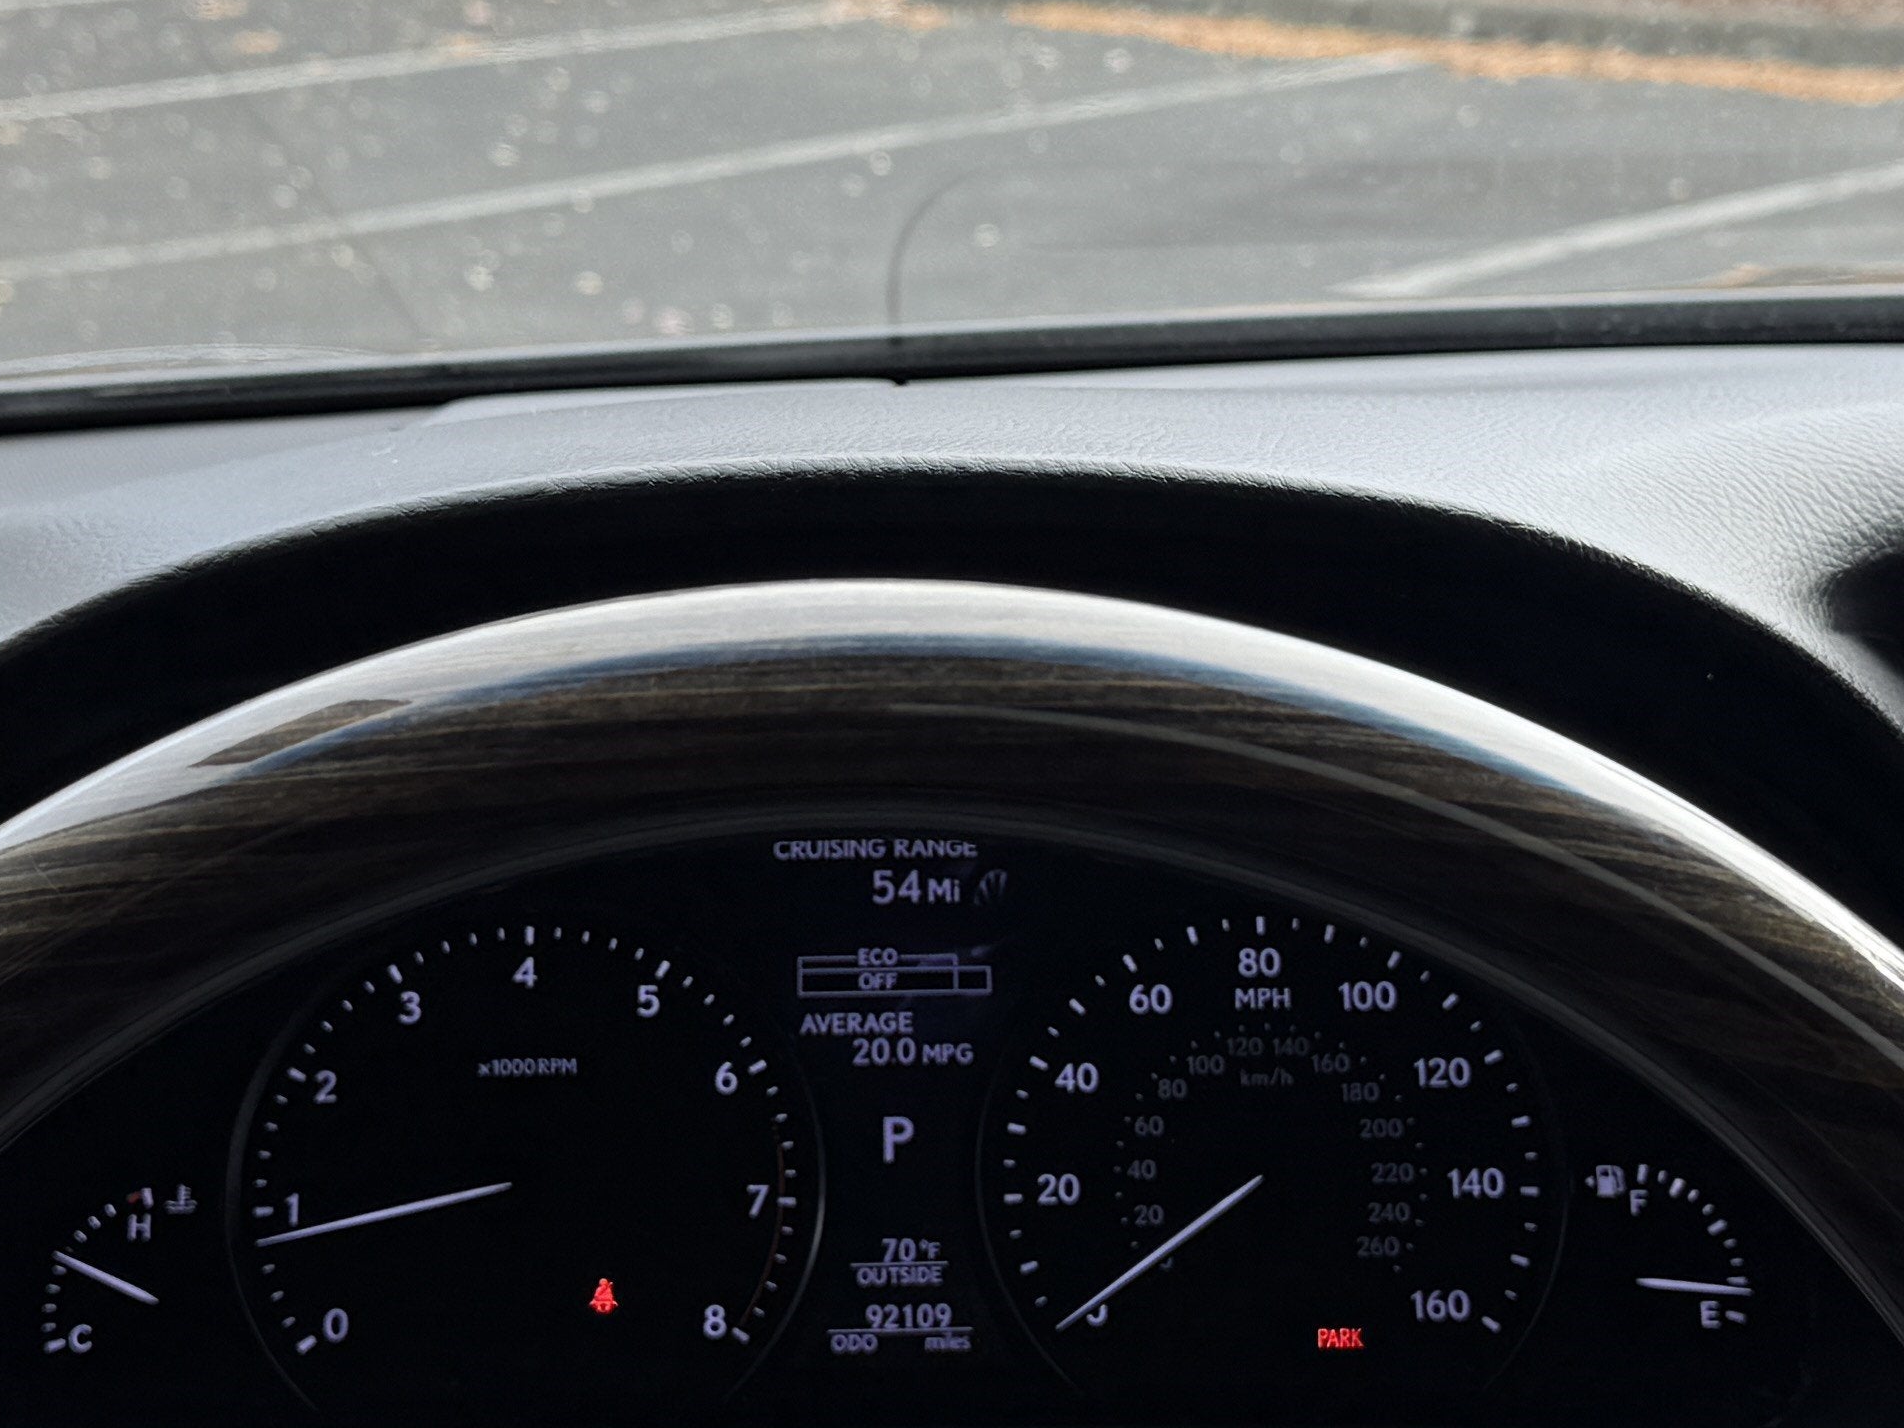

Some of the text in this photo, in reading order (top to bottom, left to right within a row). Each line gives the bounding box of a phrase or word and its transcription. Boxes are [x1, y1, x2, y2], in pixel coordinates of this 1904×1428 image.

[773, 838, 978, 860] CRUISING RANGE
[872, 869, 961, 905] 54 Mi
[857, 947, 898, 967] ECO
[1238, 947, 1282, 979] 80
[512, 956, 538, 988] 4
[858, 973, 897, 990] OFF
[398, 990, 423, 1026] 3
[635, 985, 661, 1019] 5
[1128, 983, 1173, 1015] 60
[1234, 987, 1291, 1010] MPH
[1337, 980, 1397, 1012] 100
[800, 1011, 914, 1036] AVERAGE
[922, 1043, 974, 1066] MPG
[1227, 1037, 1264, 1056] 120
[1273, 1037, 1310, 1056] 140
[1185, 1054, 1226, 1075] 100
[1311, 1053, 1351, 1073] 160
[1412, 1056, 1472, 1089] 120
[313, 1072, 338, 1104] 2
[714, 1063, 739, 1095] 6
[1054, 1062, 1099, 1094] 40
[1157, 1078, 1188, 1100] 80
[1240, 1067, 1295, 1087] km/h
[1342, 1082, 1380, 1102] 180
[1134, 1115, 1165, 1137] 60
[1360, 1118, 1404, 1139] 200
[882, 1116, 915, 1164] P
[1126, 1159, 1157, 1181] 40
[1370, 1162, 1415, 1184] 220
[1447, 1167, 1506, 1199] 140
[746, 1185, 771, 1218] 7
[1036, 1173, 1080, 1207] 20
[1630, 1189, 1649, 1217] F
[286, 1194, 300, 1226] 1
[1133, 1204, 1165, 1227] 20
[1368, 1202, 1411, 1223] 240
[127, 1214, 152, 1240] H
[1357, 1236, 1401, 1257] 260
[856, 1266, 944, 1288] OUTSIDE
[865, 1302, 952, 1330] 92109
[1409, 1289, 1471, 1322] 160
[1700, 1300, 1722, 1329] E
[322, 1308, 350, 1343] 0
[703, 1305, 727, 1340] 8
[67, 1324, 93, 1355] C
[830, 1333, 879, 1354] ODO
[1317, 1327, 1364, 1349] PARK
